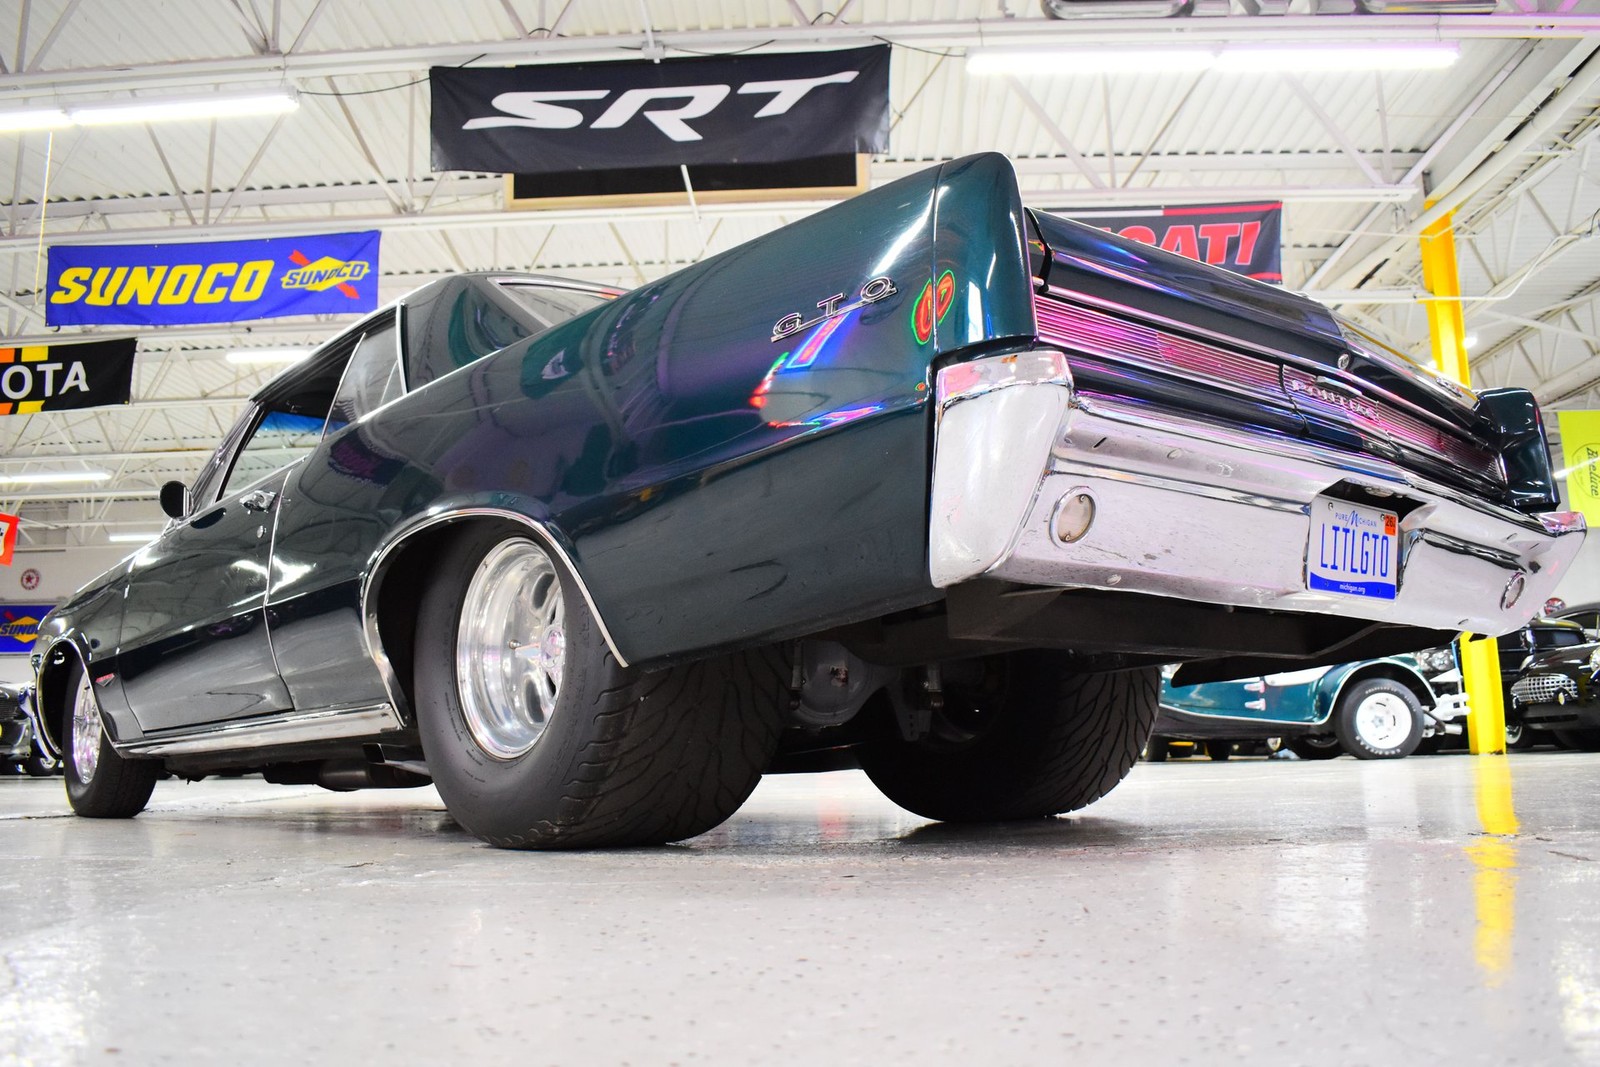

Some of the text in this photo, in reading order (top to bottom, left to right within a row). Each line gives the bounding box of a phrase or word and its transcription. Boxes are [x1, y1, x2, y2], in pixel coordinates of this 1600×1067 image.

[462, 71, 859, 142] SRT
[1100, 221, 1262, 265] ATI
[50, 260, 275, 306] SUNOCO
[285, 263, 366, 286] SUNOCO
[771, 276, 897, 342] GTO
[1320, 523, 1389, 577] LITLGTO
[1339, 583, 1366, 594] michigan.org
